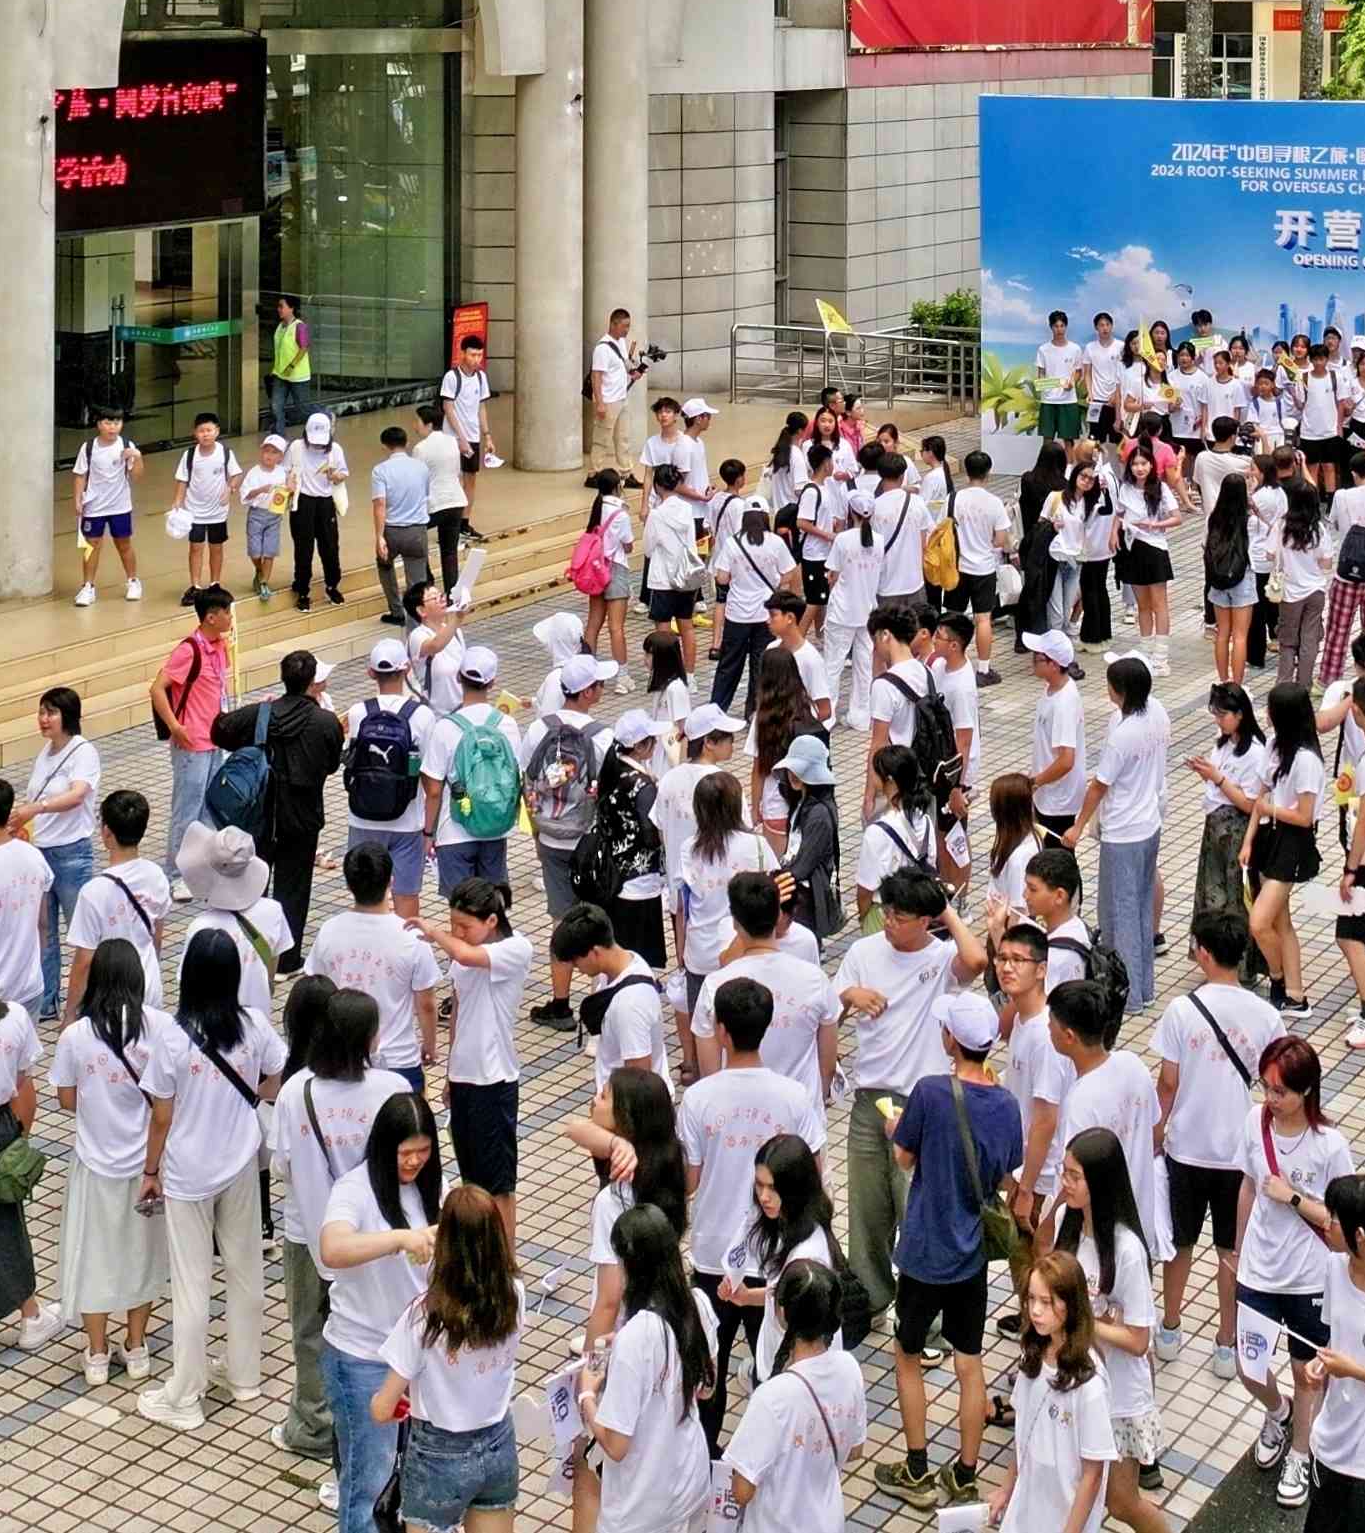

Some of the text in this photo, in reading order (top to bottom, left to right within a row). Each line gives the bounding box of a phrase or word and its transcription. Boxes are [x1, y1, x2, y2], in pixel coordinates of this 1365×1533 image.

[1151, 164, 1183, 177] 2024
[1187, 165, 1290, 180] ROOT-SEEKING
[1294, 167, 1357, 181] SUMMER
[1241, 180, 1268, 192] FOR
[1272, 180, 1344, 194] OVERSEAS
[1292, 253, 1358, 269] OPENING
